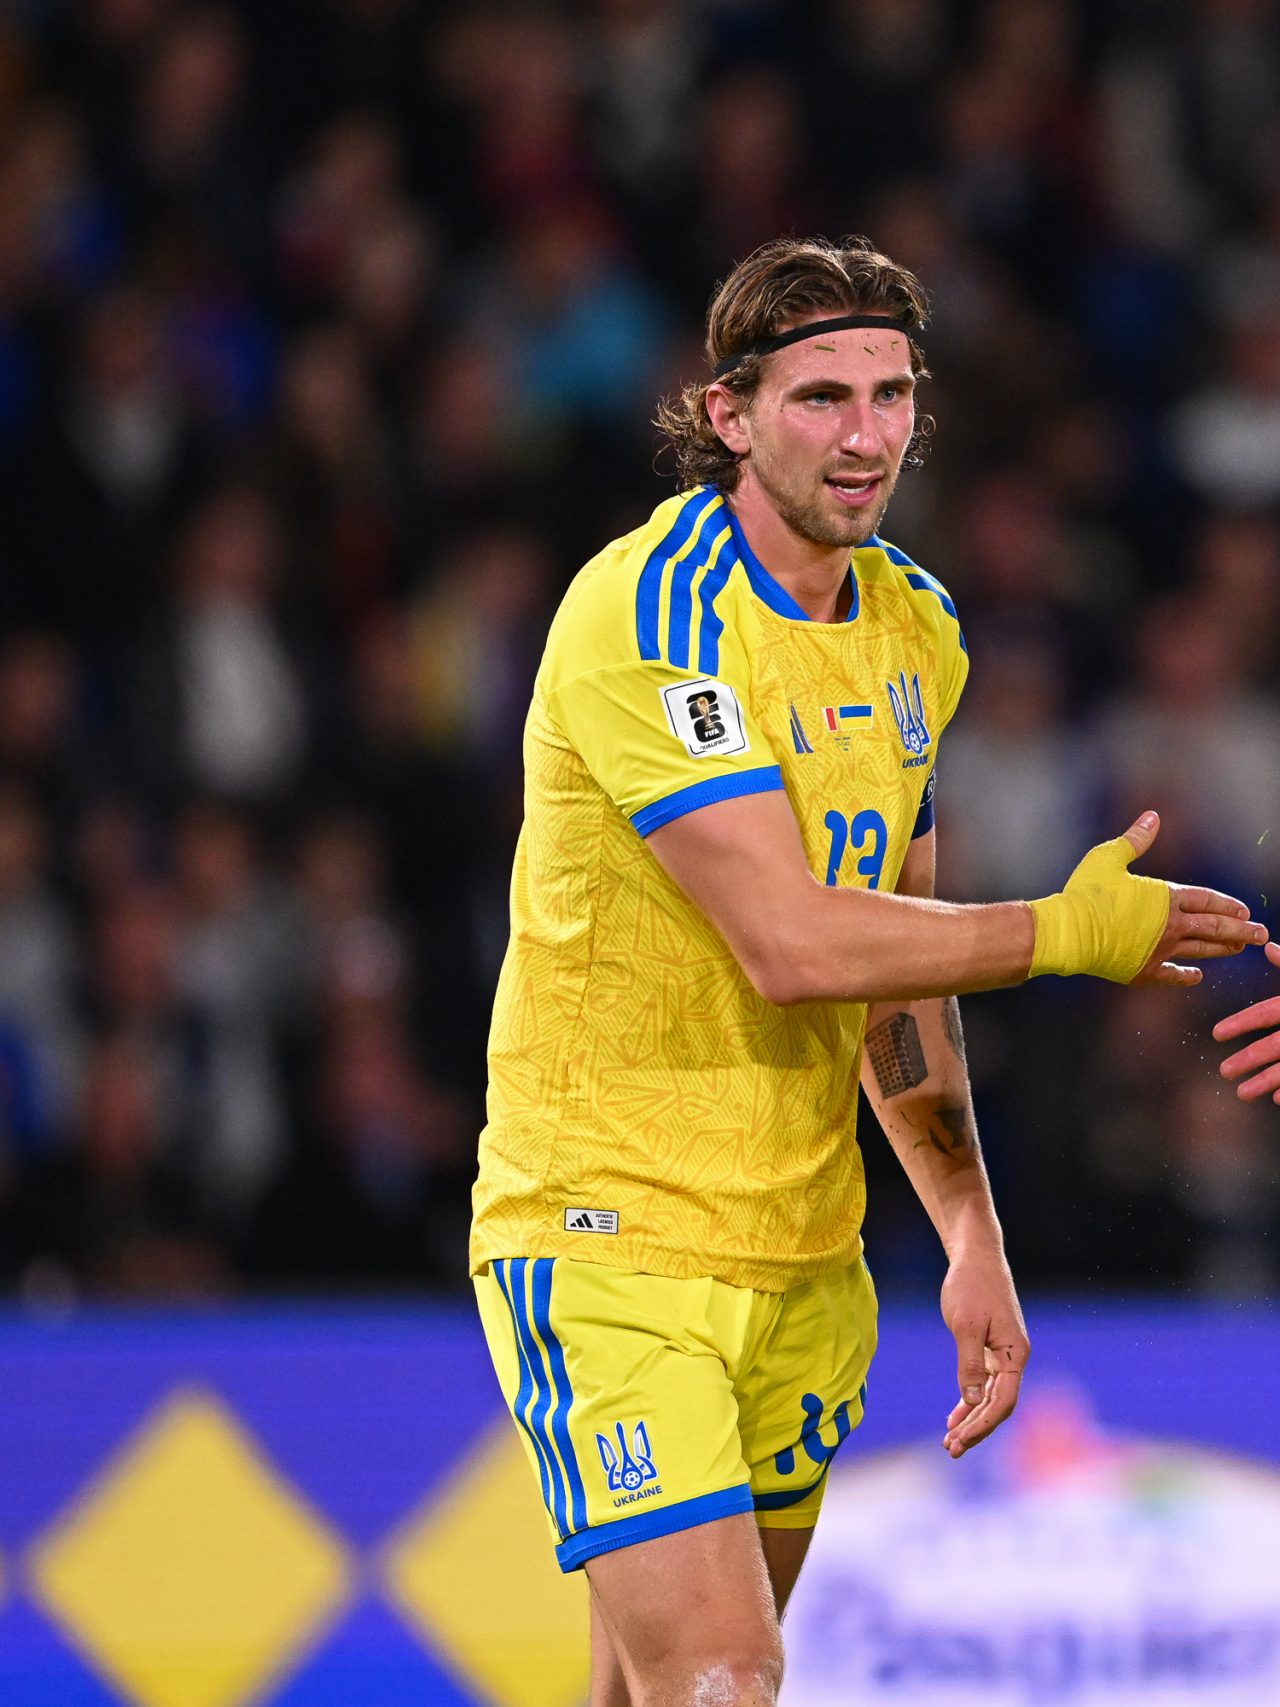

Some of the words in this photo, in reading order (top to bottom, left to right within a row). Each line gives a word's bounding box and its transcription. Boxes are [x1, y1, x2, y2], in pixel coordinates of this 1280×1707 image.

[704, 728, 720, 738] FIFA
[700, 737, 730, 750] QUALIFIERS
[614, 1485, 663, 1508] UKRAINE
